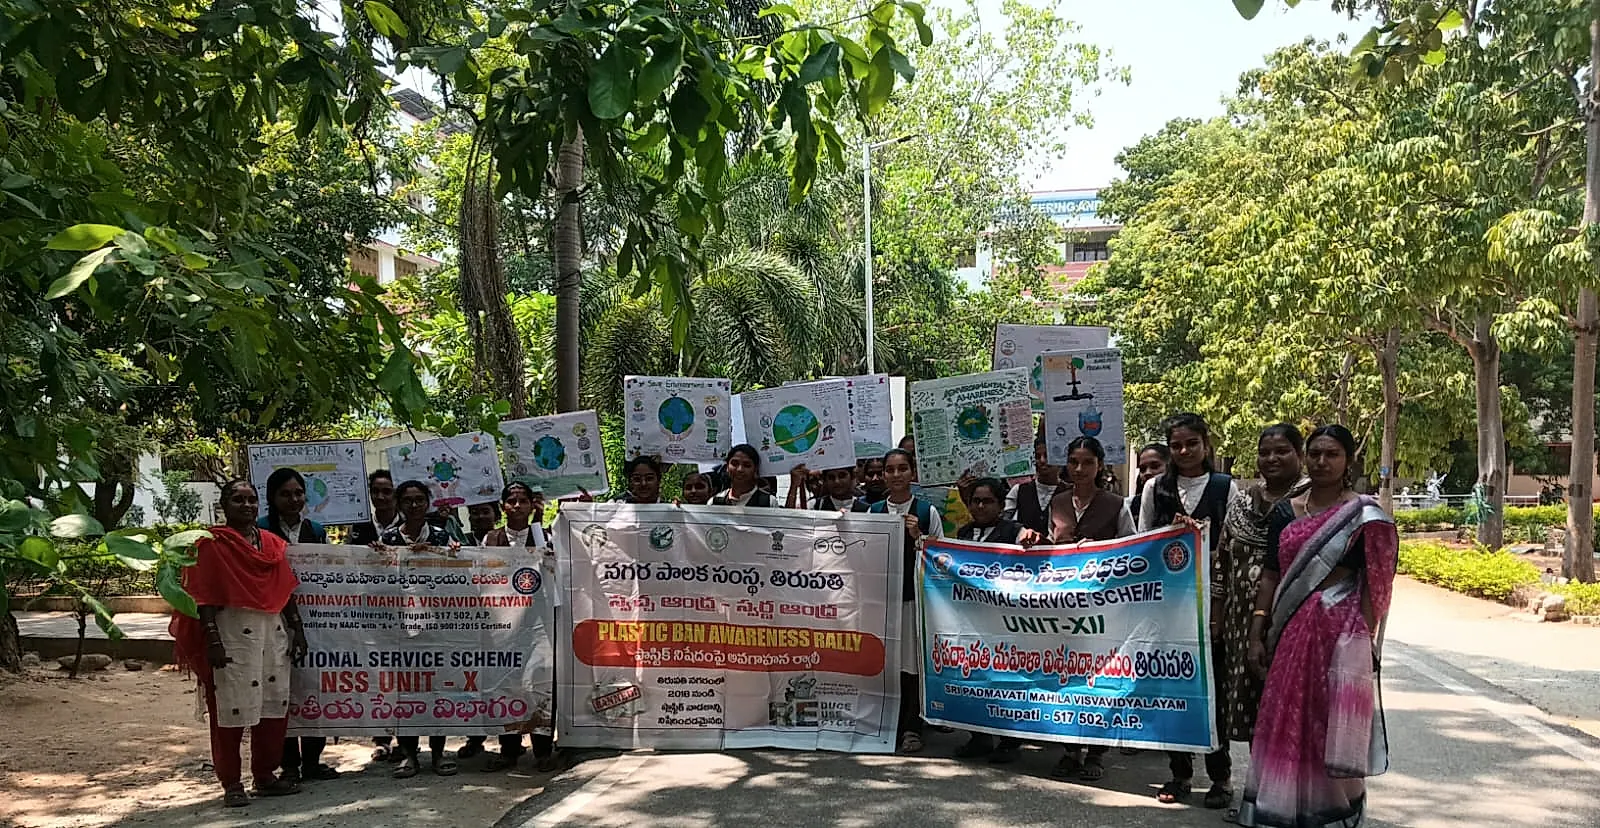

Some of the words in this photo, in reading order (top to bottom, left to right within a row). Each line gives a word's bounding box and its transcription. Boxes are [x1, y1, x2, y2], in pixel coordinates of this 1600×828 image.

[956, 389, 1005, 402] AWARENESS
[604, 562, 651, 580] నగర
[656, 562, 709, 582] పాలక
[712, 565, 764, 596] సంస్థ,
[770, 570, 844, 590] తిరుపతి
[366, 595, 416, 607] MAHILA
[419, 596, 532, 608] VISVAVIDYALAYAM
[953, 584, 1016, 608] NATIONAL
[1019, 592, 1089, 609] SERVICE
[1092, 582, 1163, 607] SCHEME
[309, 609, 348, 618] Women's
[351, 610, 395, 620] University,
[453, 611, 473, 620] 502,
[475, 611, 490, 619] A.P.
[1002, 614, 1105, 634] UNIT-XII
[330, 622, 338, 630] by
[400, 622, 424, 631] Grade,
[598, 622, 668, 642] PLASTIC
[672, 624, 705, 643] BAN
[709, 625, 810, 648] AWARENESS
[813, 631, 863, 652] RALLY
[368, 651, 444, 668] SERVICE
[450, 651, 523, 668] SCHEME
[728, 651, 790, 665] అవగాహన
[941, 640, 991, 677] పద్మావతి
[992, 642, 1041, 671] మహిళా
[1135, 650, 1195, 678] తిరుపతి
[321, 671, 369, 693] NSS
[379, 671, 436, 693] UNIT
[463, 671, 479, 692] X
[667, 690, 690, 698] 2018
[945, 684, 960, 695] SRI
[963, 688, 1026, 701] PADMAVATI
[1029, 692, 1071, 704] MAHILA
[1074, 695, 1186, 710] VISVAVIDYALAYAM
[370, 693, 427, 719] సేవా
[433, 696, 528, 722] విభాగం
[987, 705, 1040, 720] Tirupati
[1053, 712, 1074, 723] 517
[1079, 713, 1108, 727] 502,
[1112, 716, 1143, 727] A.P.
